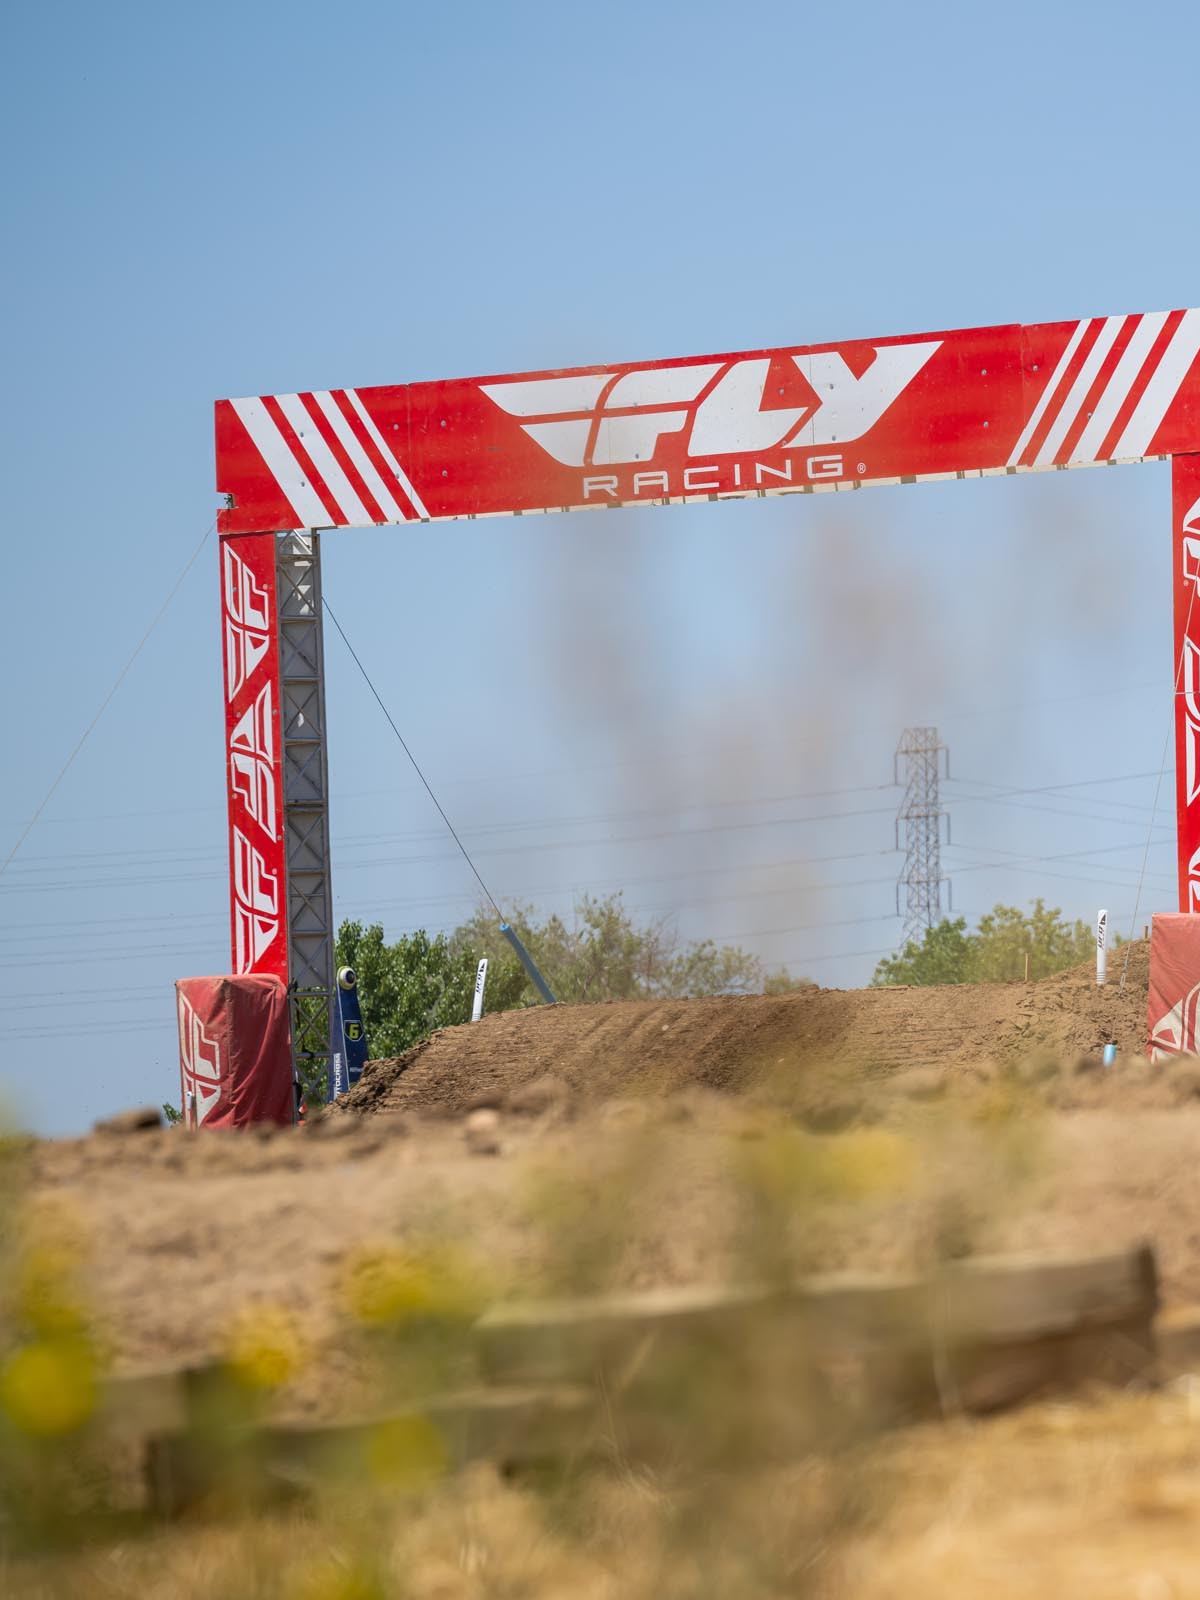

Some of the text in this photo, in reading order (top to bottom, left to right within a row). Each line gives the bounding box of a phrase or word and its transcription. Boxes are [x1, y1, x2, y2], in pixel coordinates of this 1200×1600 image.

[478, 340, 945, 467] FLY
[582, 454, 844, 499] RACING
[349, 1023, 360, 1039] 6
